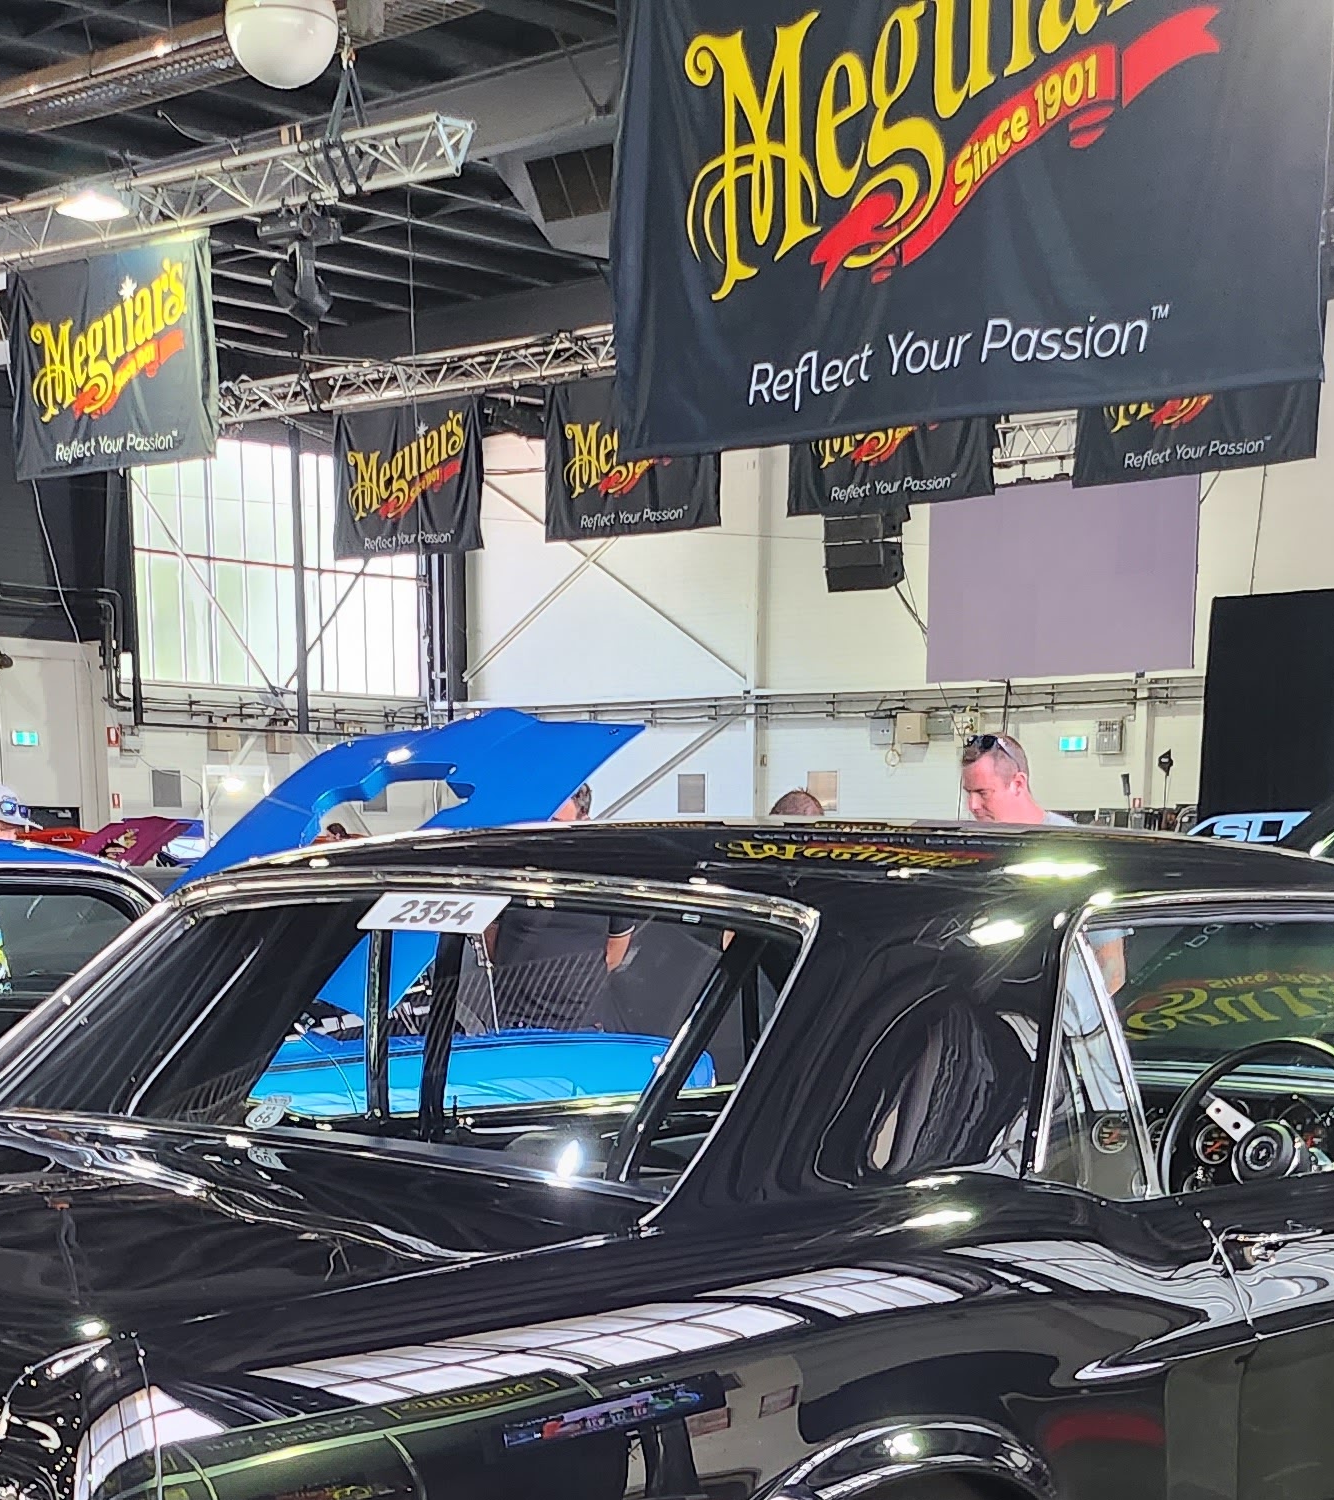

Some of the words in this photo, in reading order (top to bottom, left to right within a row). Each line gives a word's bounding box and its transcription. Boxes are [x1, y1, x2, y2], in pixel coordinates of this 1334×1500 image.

[953, 108, 1029, 206] Since
[1033, 53, 1099, 129] 1901
[30, 257, 187, 423] Meguiar's
[747, 340, 875, 412] Reflect
[886, 328, 973, 377] Your
[56, 439, 96, 464] Reflect
[98, 434, 125, 456] Your
[1123, 449, 1170, 471] Reflect
[1174, 443, 1207, 461] Your
[347, 410, 465, 522] Meguiar's
[830, 481, 871, 504] Reflect
[873, 478, 901, 495] Your
[580, 512, 615, 531] Reflect
[617, 509, 641, 524] Your
[364, 534, 397, 552] Reflect
[387, 899, 476, 926] 2354
